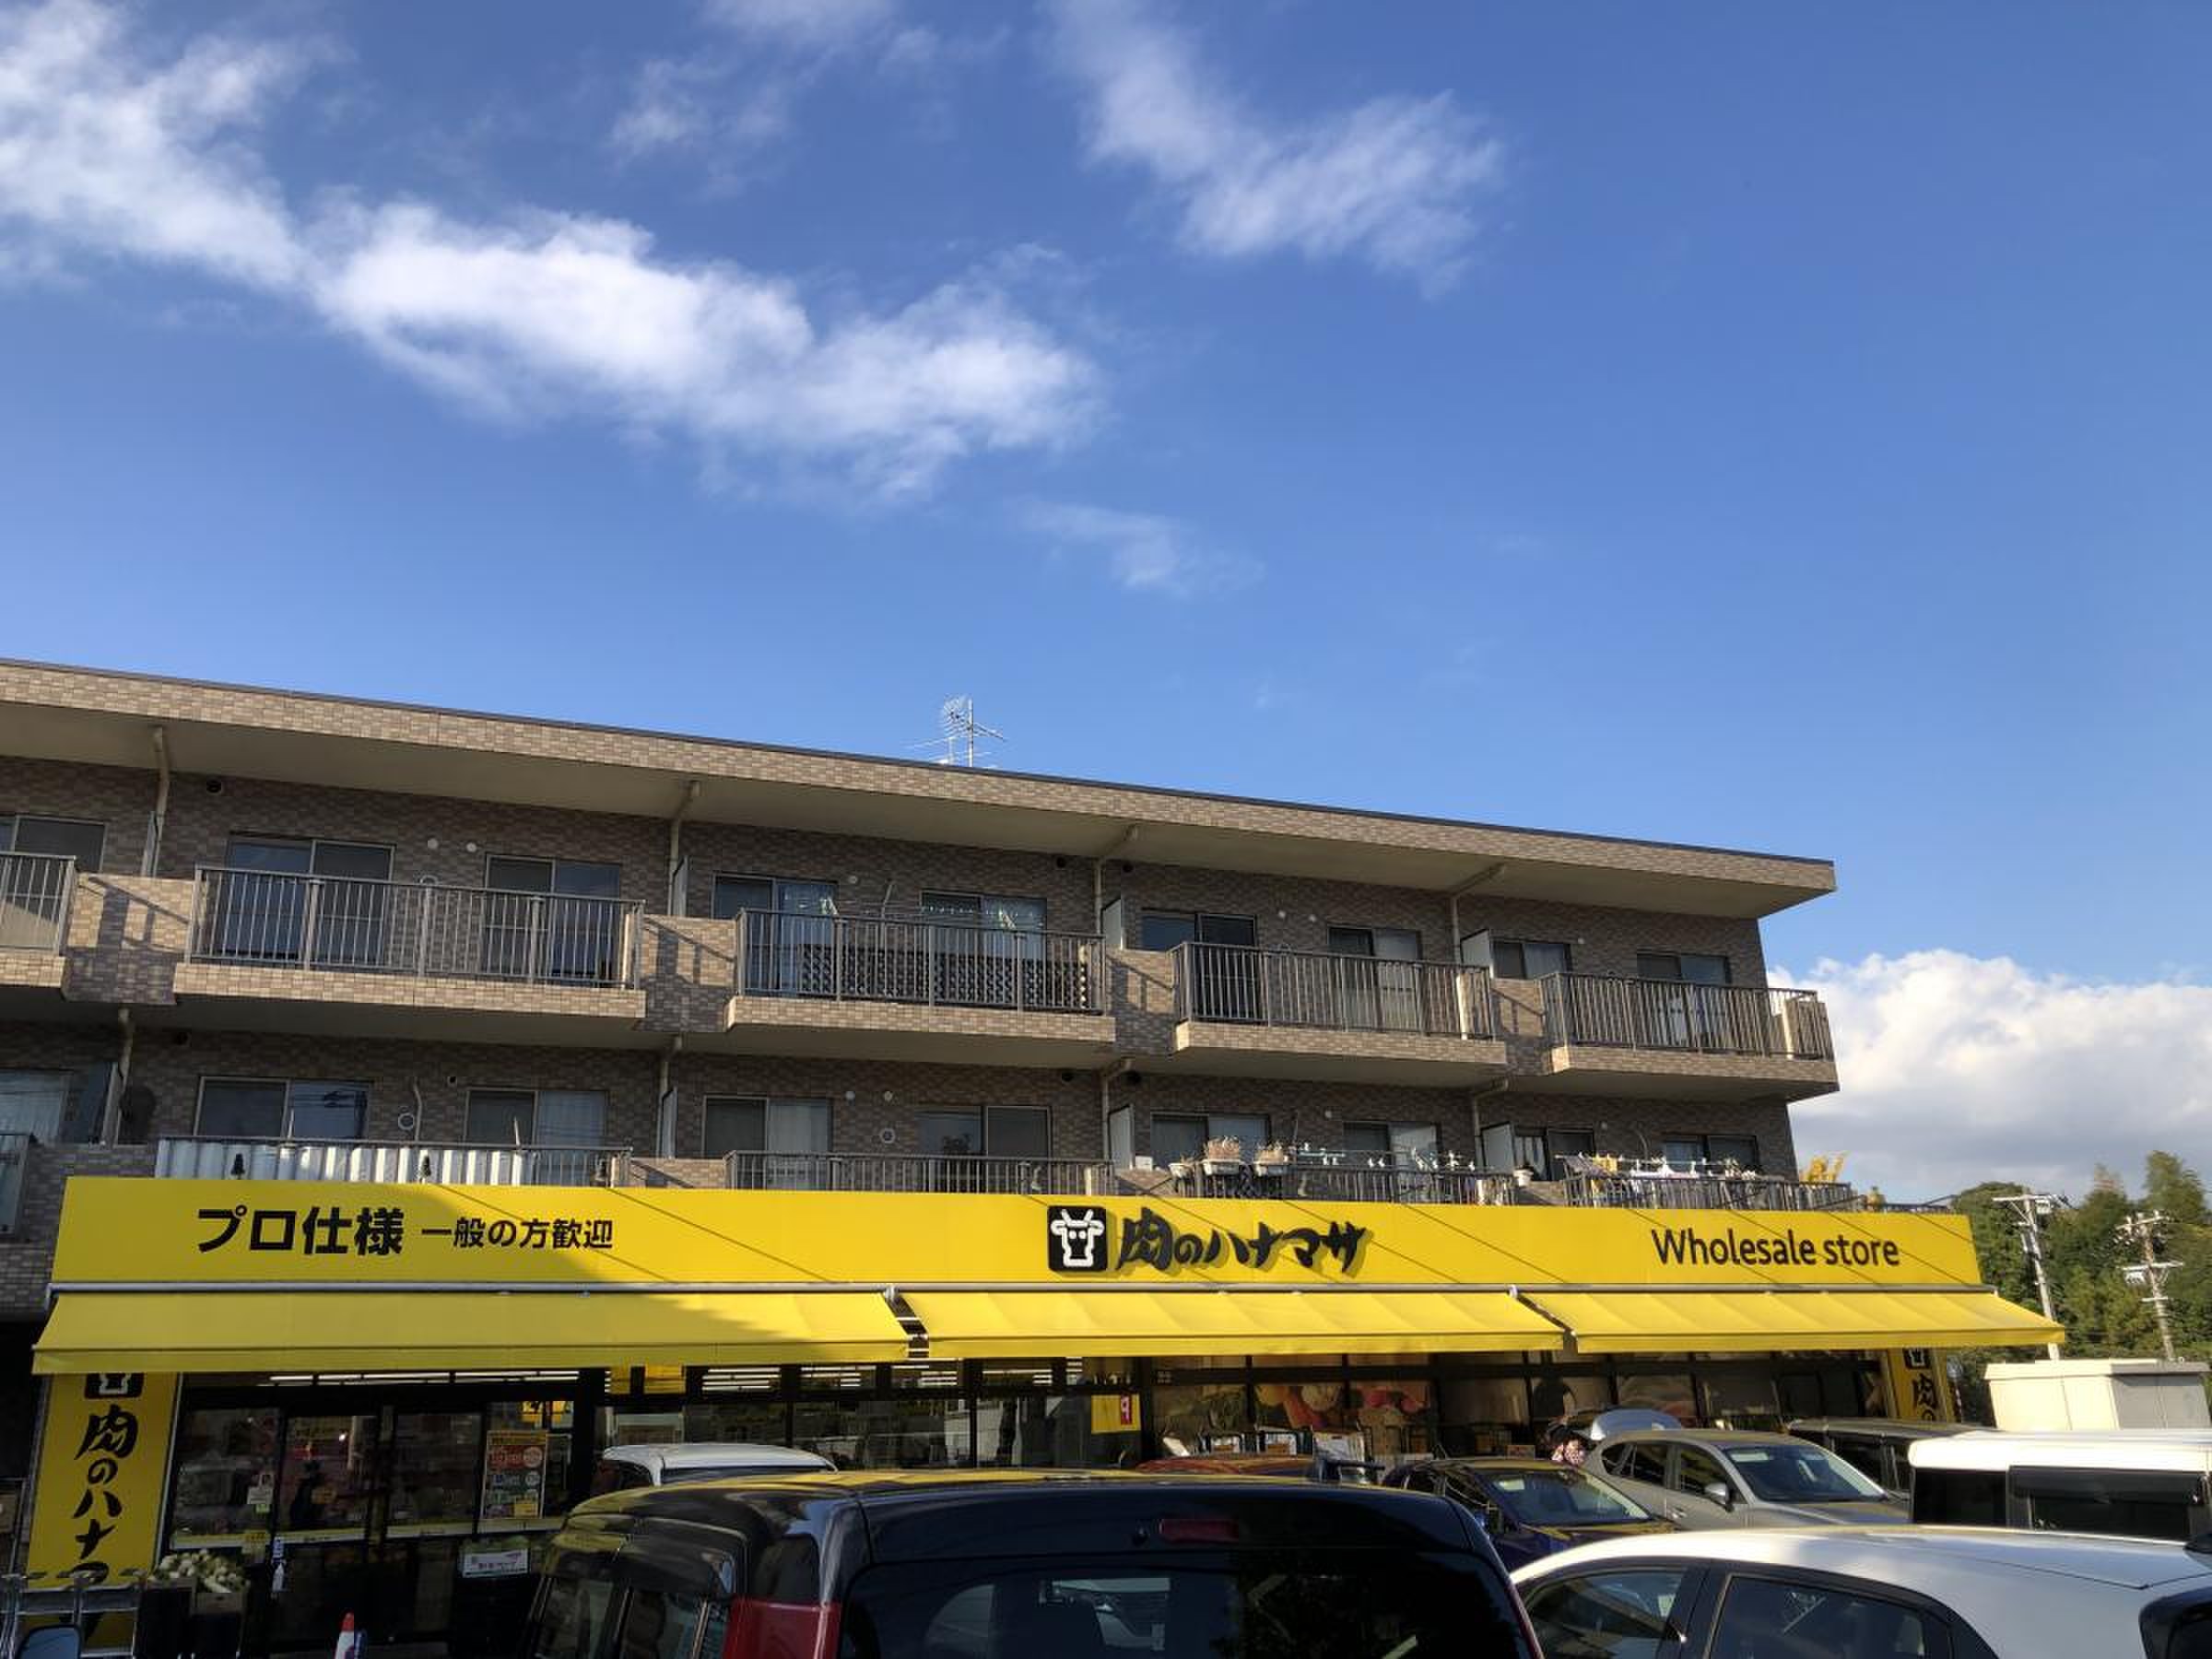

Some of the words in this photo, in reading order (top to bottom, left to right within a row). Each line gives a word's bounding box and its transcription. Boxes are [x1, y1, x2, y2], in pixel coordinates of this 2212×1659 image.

[198, 1205, 404, 1255] プロ仕様
[421, 1217, 613, 1249] 一般の方歓迎
[1115, 1206, 1367, 1273] 肉のハナマサ
[1651, 1228, 1816, 1265] Wholesale
[1824, 1234, 1900, 1265] store
[73, 1404, 138, 1642] 肉のハナ
